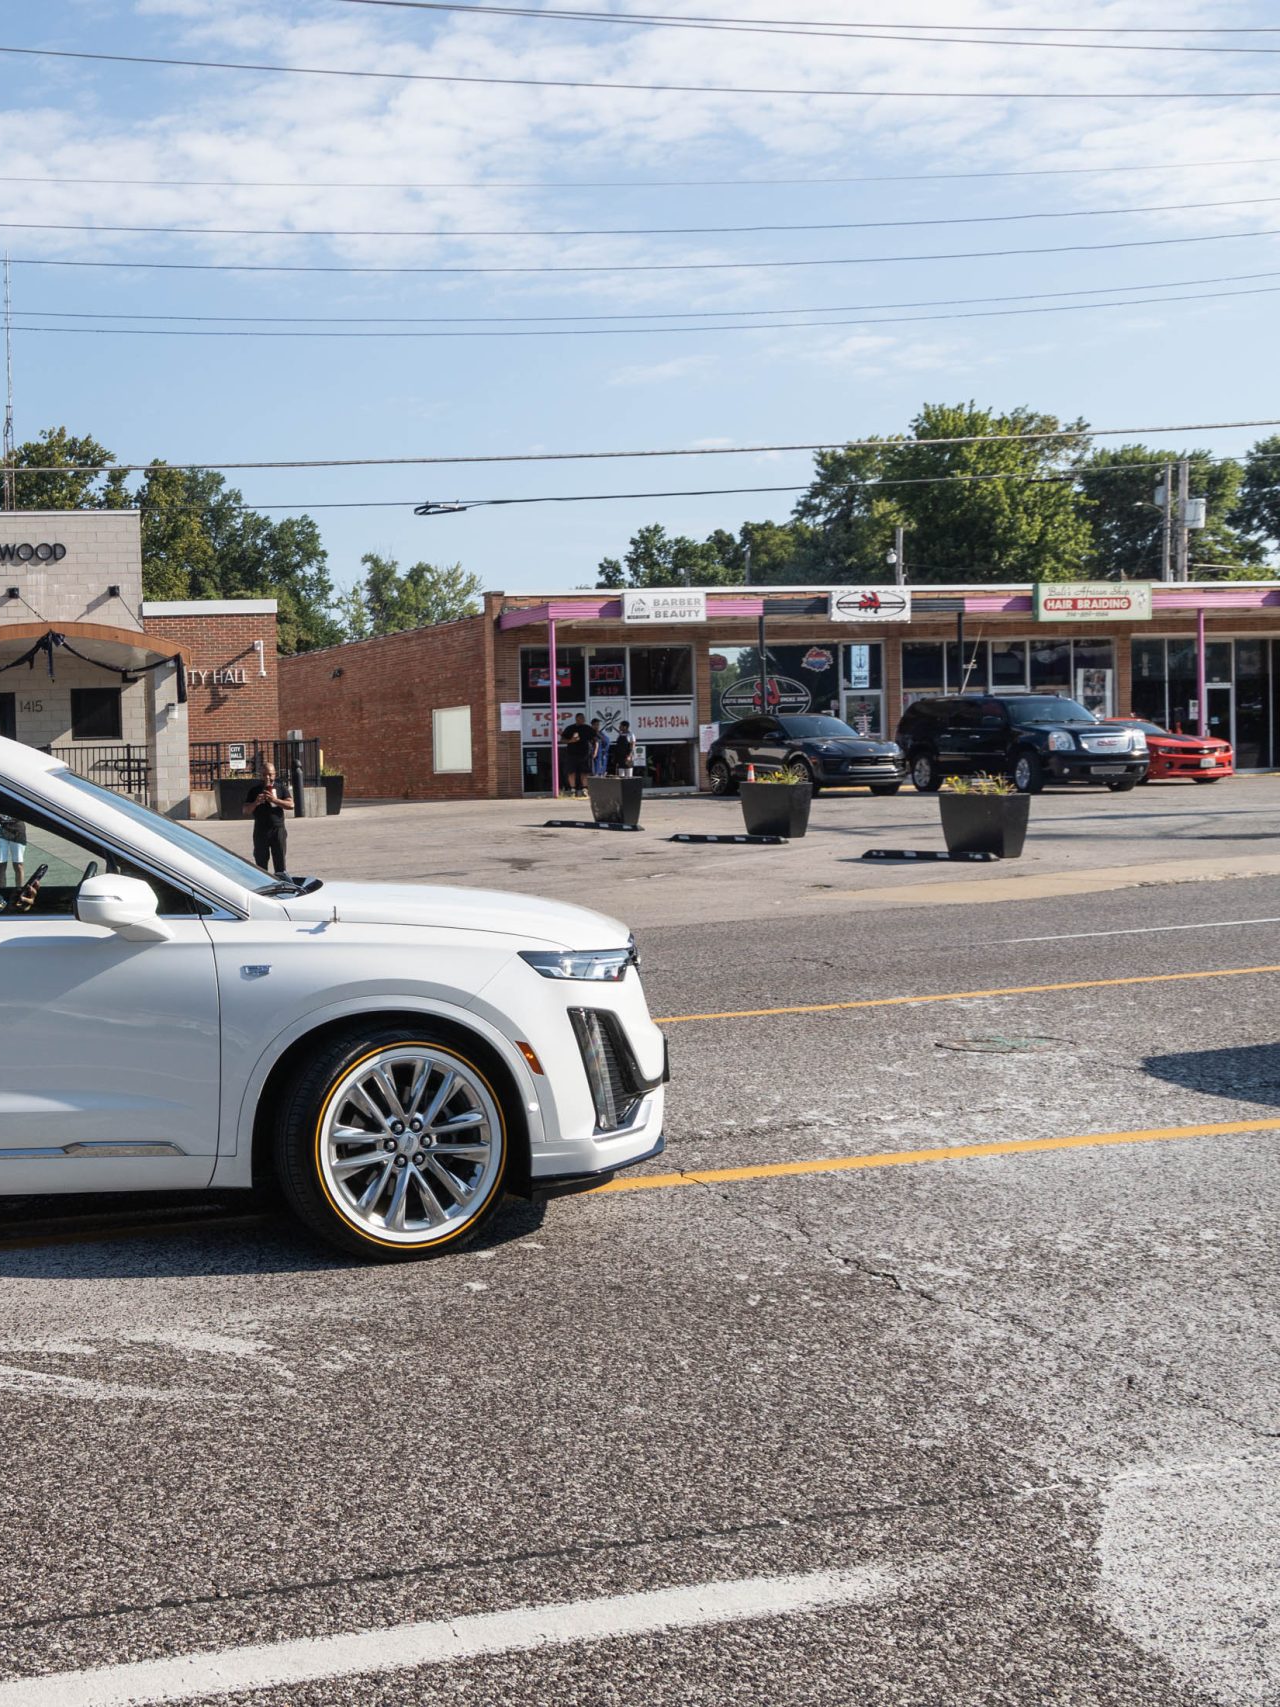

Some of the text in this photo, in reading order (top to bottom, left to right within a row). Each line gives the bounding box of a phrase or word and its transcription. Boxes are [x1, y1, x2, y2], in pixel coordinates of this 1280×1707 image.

[653, 598, 702, 607] BARBER
[1046, 598, 1129, 609] HAIR BRAIDING
[654, 609, 700, 618] BEAUTY
[189, 668, 250, 685] TY HALL
[589, 666, 624, 680] OPEN
[20, 700, 43, 712] 1415
[532, 712, 573, 721] TOP
[637, 715, 689, 728] 314-521-0344
